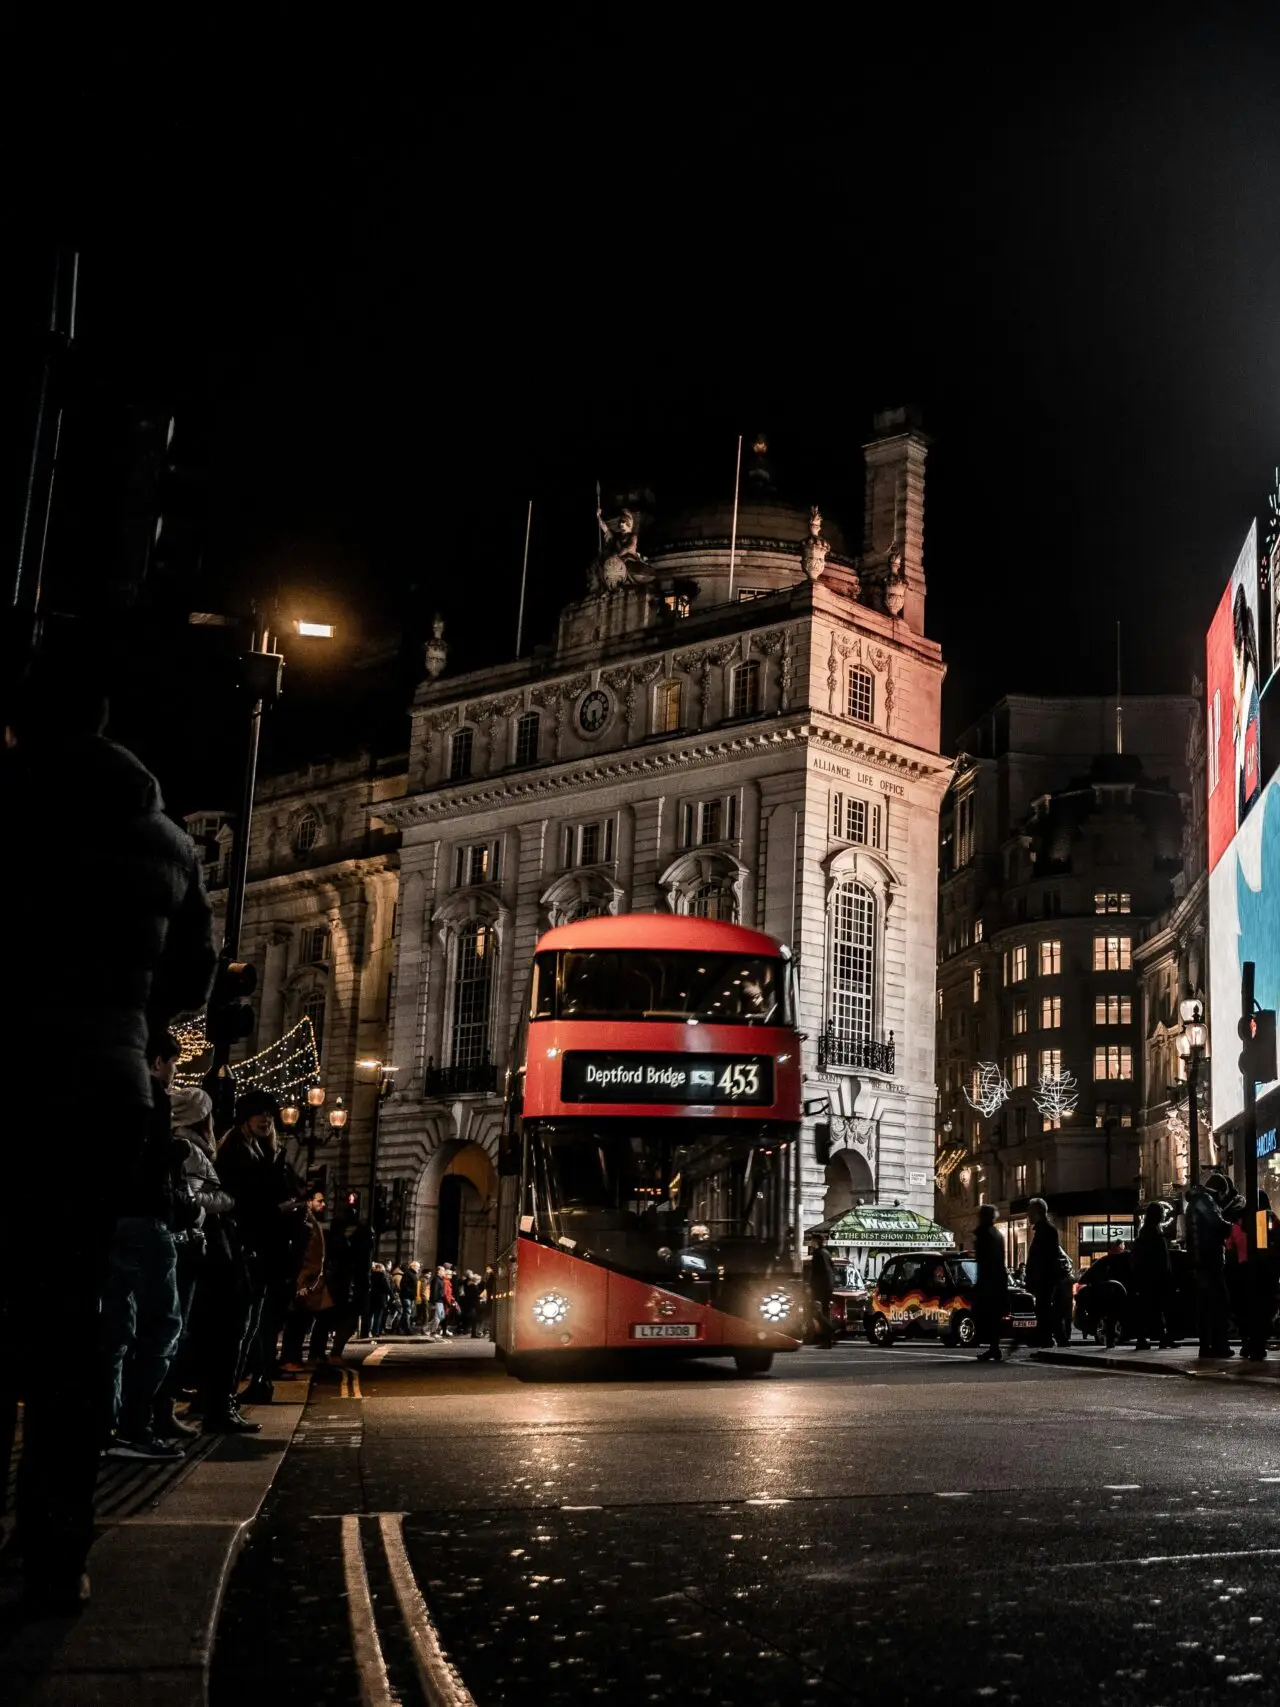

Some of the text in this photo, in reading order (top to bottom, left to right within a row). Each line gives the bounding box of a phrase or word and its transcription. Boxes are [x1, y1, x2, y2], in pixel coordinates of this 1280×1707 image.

[813, 757, 905, 796] ALLIANCE LIFE OFFICE
[586, 1064, 643, 1088] Deptford
[646, 1066, 686, 1088] Bridge
[717, 1063, 760, 1096] 453
[859, 1217, 919, 1230] WICKED
[881, 1233, 904, 1241] SHOW
[1101, 1228, 1123, 1238] UGG
[890, 1305, 909, 1321] Ride
[924, 1306, 951, 1321] Pride
[641, 1326, 663, 1336] LTZ
